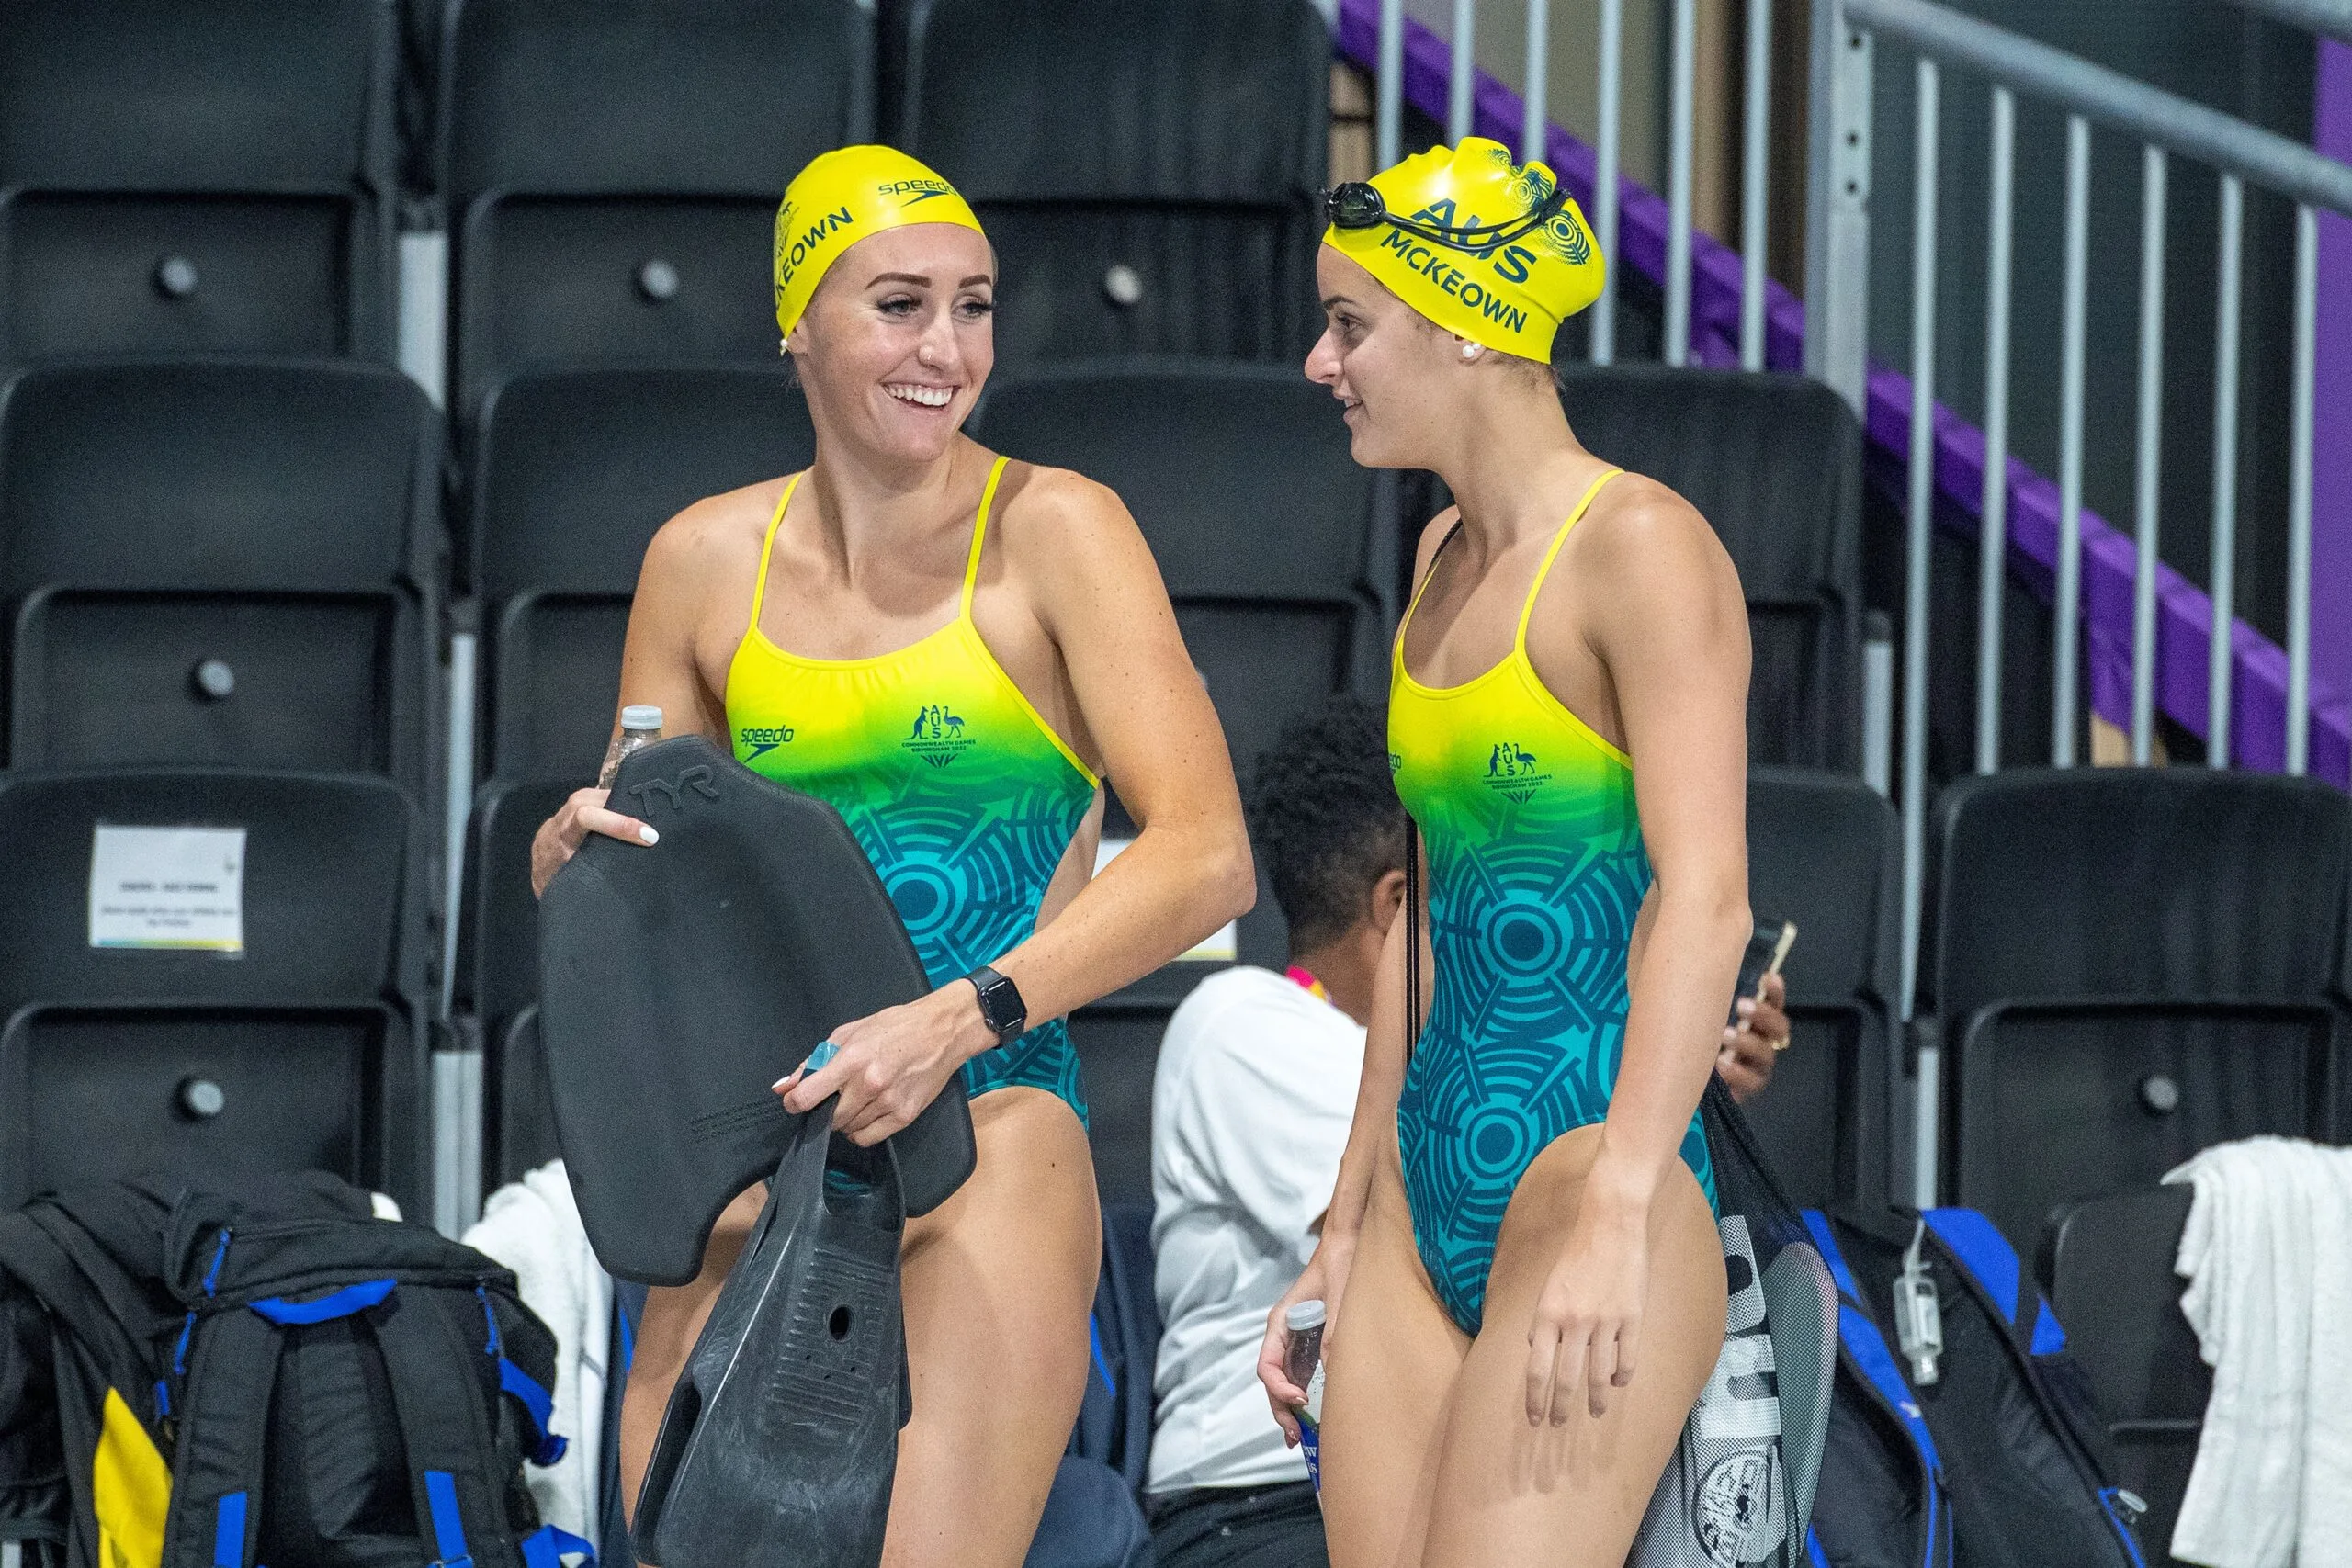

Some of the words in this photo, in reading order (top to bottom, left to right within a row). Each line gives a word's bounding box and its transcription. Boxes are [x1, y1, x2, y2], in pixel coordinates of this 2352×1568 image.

[878, 179, 957, 196] speedo
[776, 207, 854, 311] KEOWN
[1410, 198, 1538, 284] AUS
[1380, 229, 1528, 333] MCKEOWN
[741, 724, 795, 746] speedo
[629, 764, 721, 818] TYR
